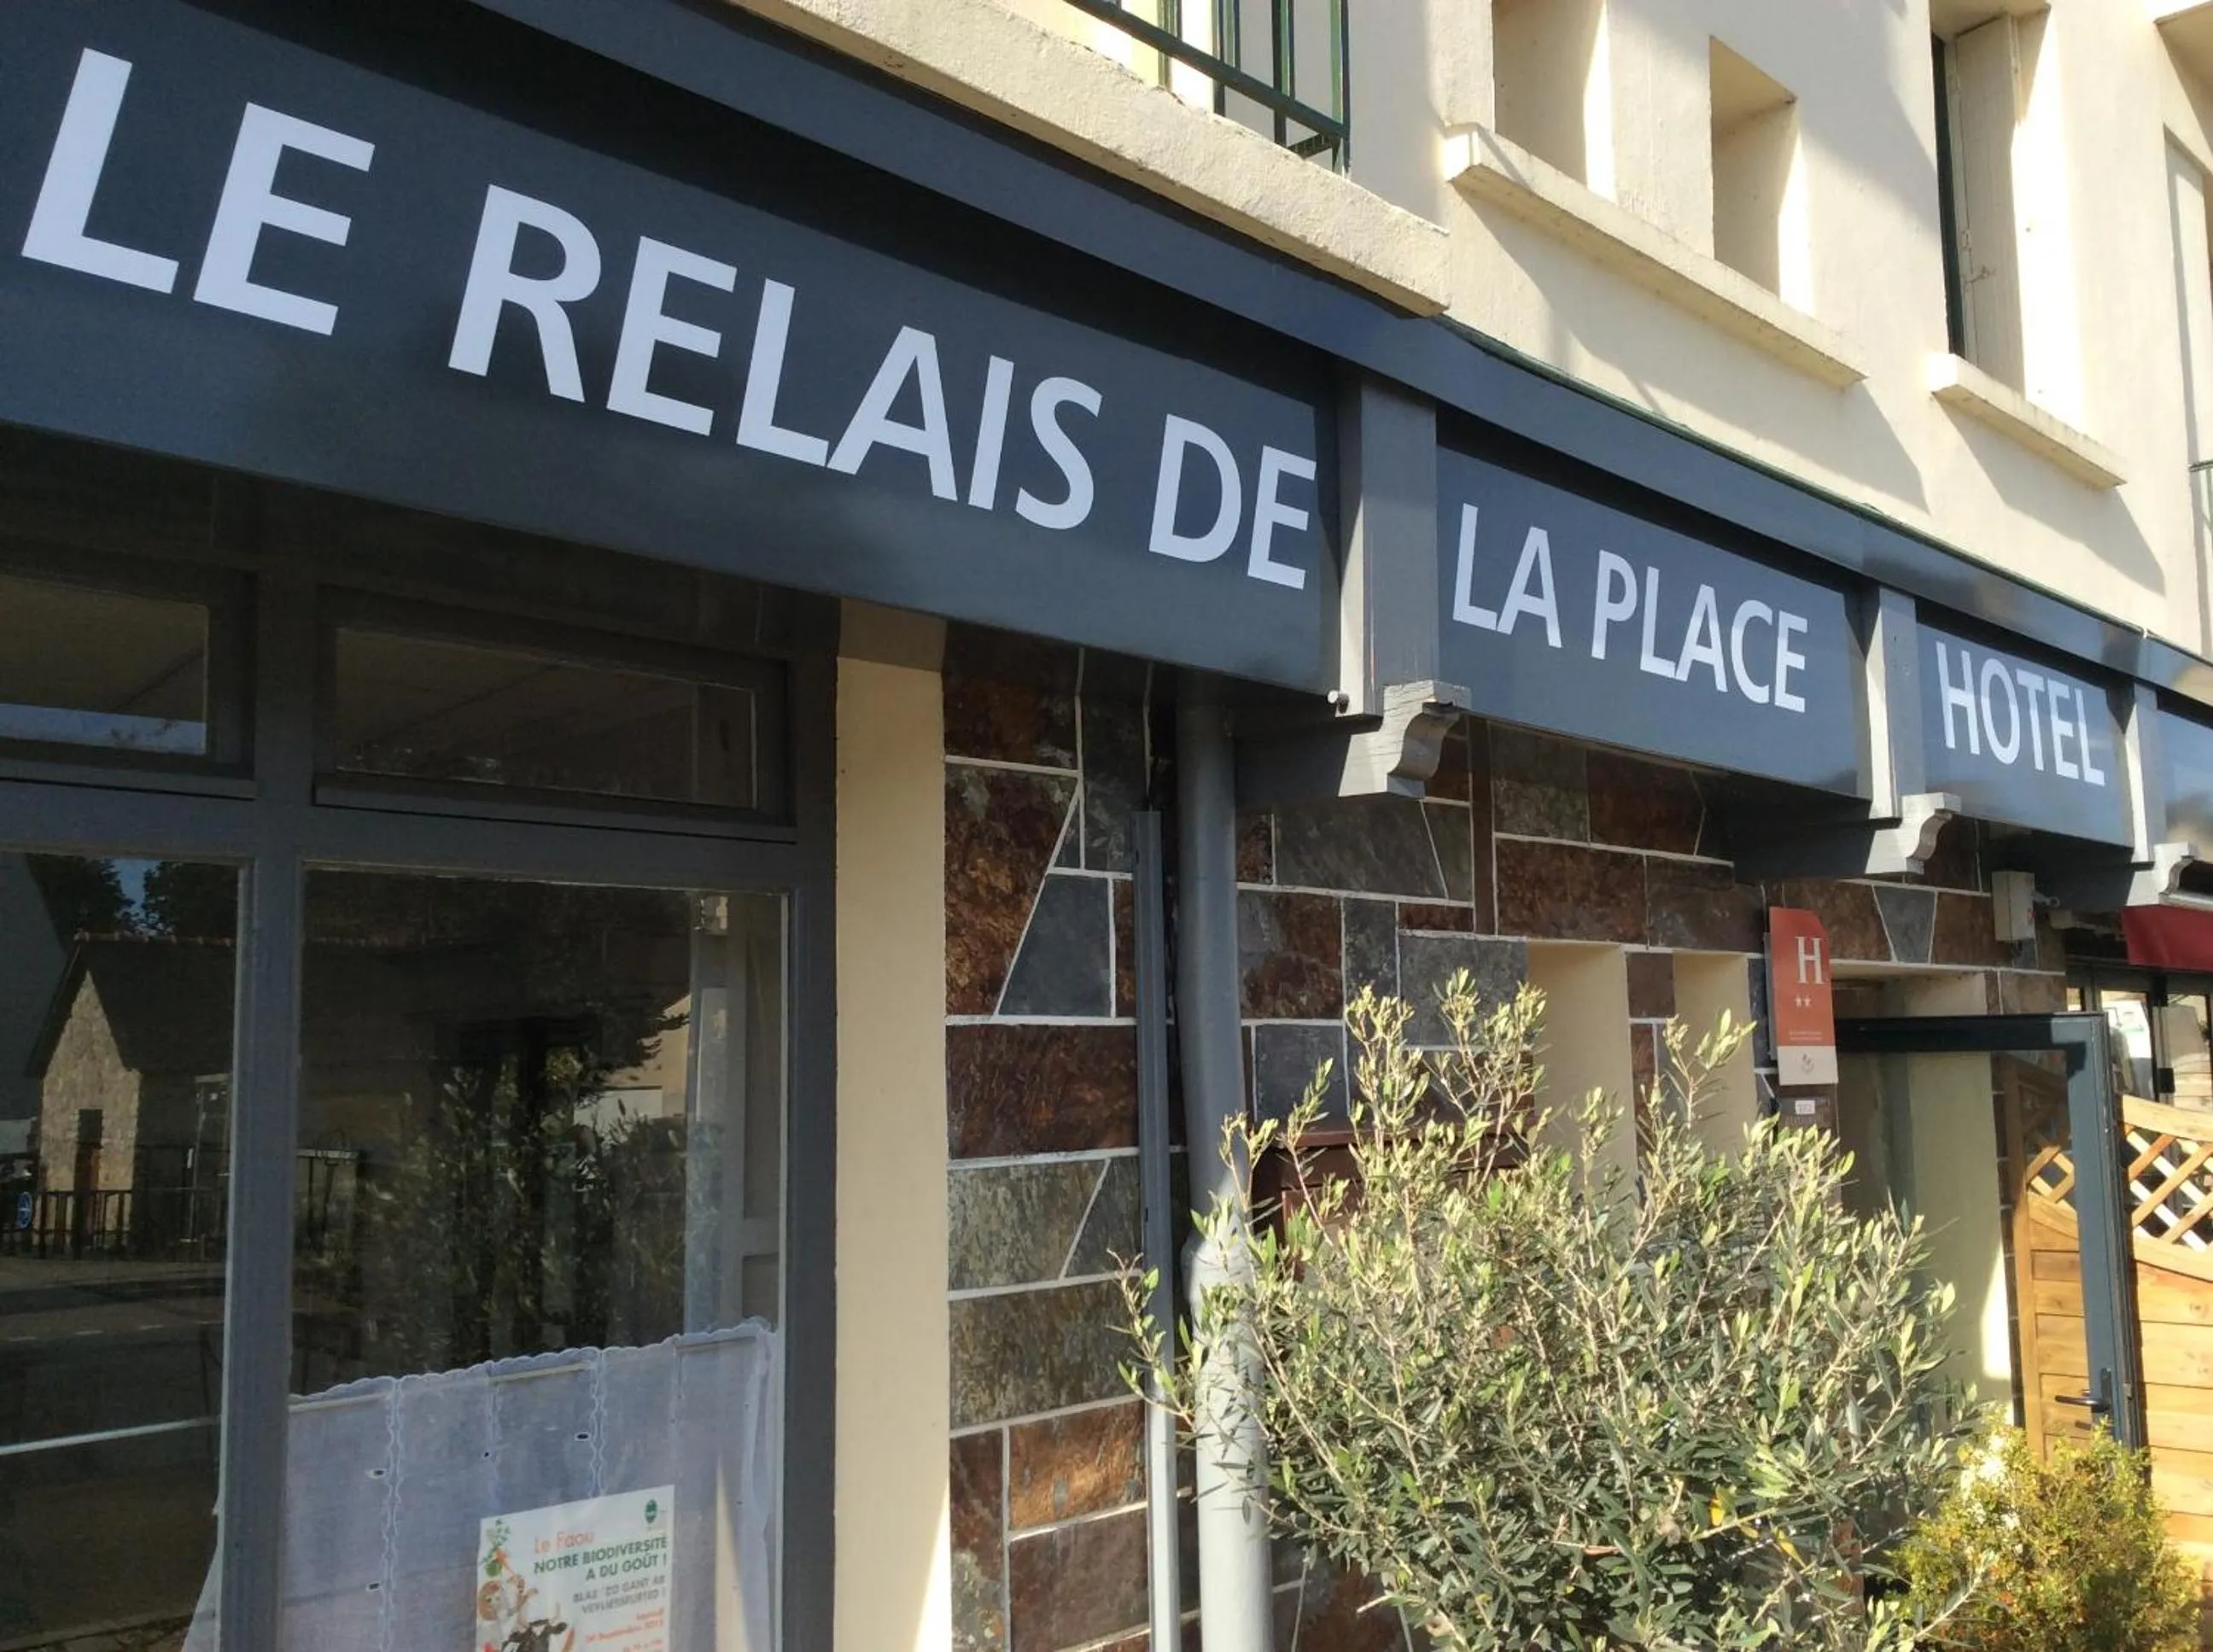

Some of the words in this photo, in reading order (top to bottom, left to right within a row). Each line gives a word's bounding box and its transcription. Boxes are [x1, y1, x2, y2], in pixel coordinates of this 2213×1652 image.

[21, 47, 376, 336] LE
[447, 184, 1103, 530] RELAIS
[1148, 413, 1317, 590] DE
[1453, 503, 1562, 649] LA
[1591, 549, 1808, 713] PLACE
[1936, 641, 2105, 787] HOTEL
[1795, 936, 1825, 985] H
[534, 1537, 552, 1554] Le
[556, 1531, 595, 1552] Faou
[533, 1553, 579, 1574] NOTRE
[586, 1567, 596, 1581] A
[599, 1563, 618, 1579] DU
